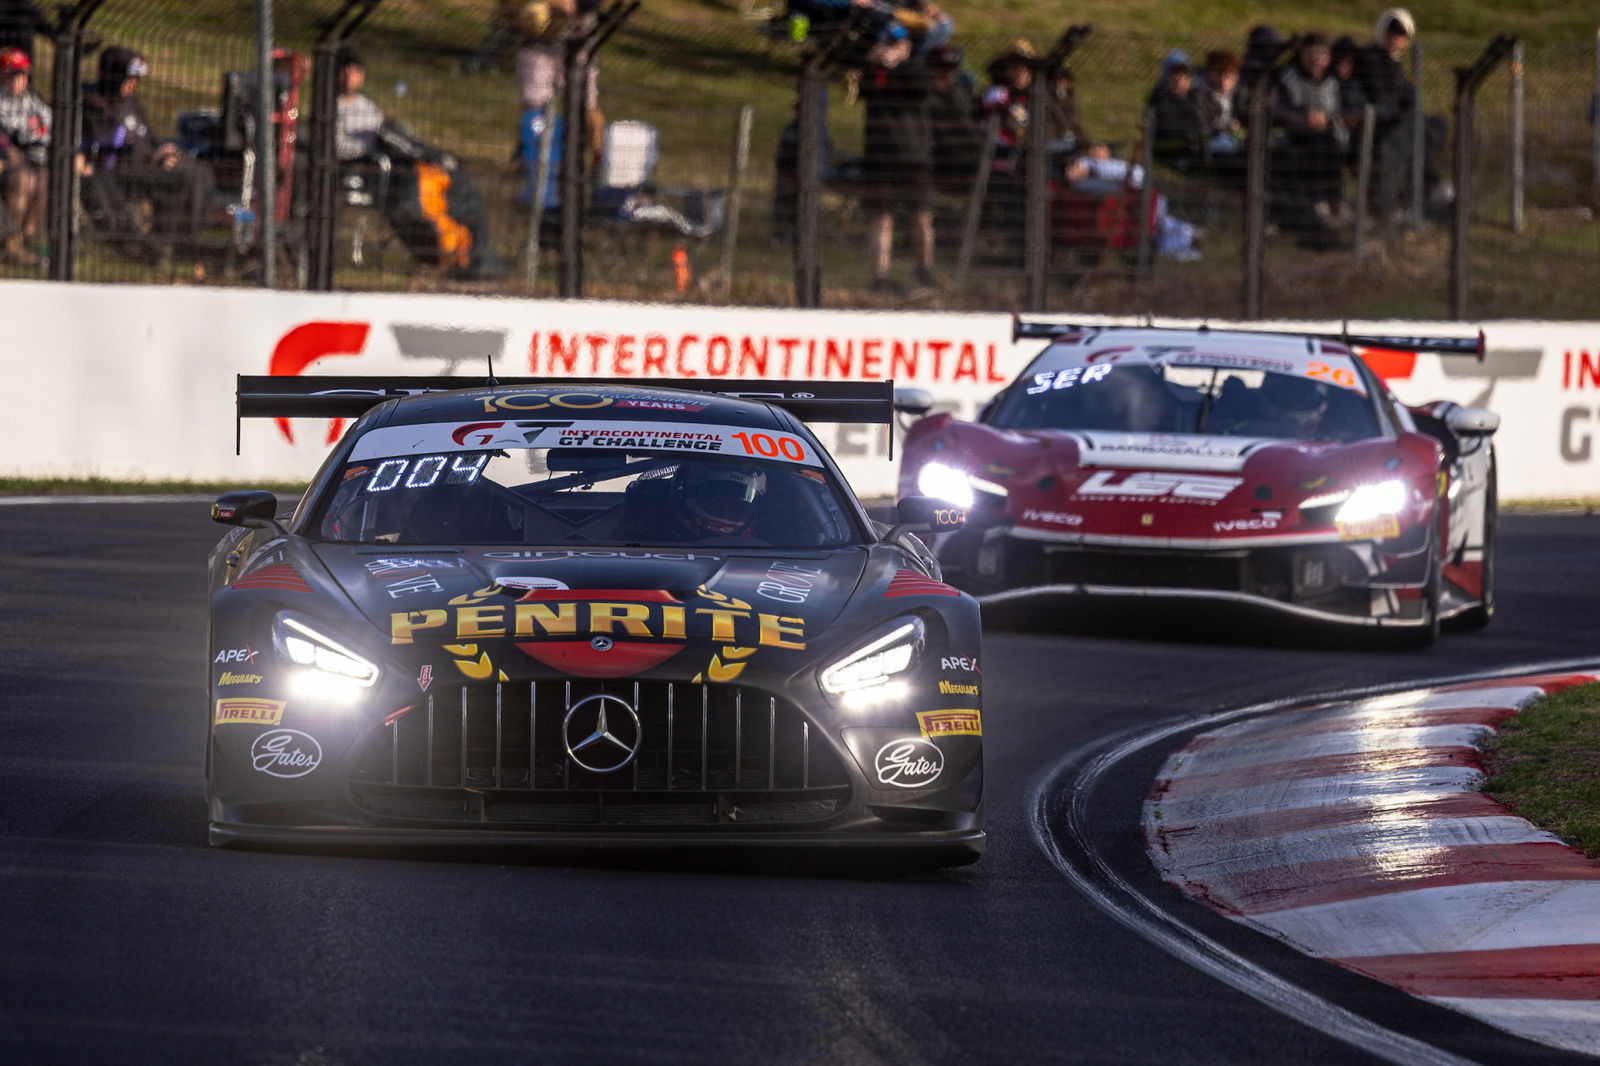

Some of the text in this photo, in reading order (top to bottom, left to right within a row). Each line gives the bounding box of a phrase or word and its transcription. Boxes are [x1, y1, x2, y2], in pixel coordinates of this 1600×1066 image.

[528, 329, 1006, 385] INTERCONTINENTAL
[1026, 362, 1113, 395] SER
[1304, 360, 1356, 387] 26
[626, 400, 686, 410] YEARS
[558, 436, 723, 451] GT CHALLENGE
[561, 429, 724, 442] INTERCONTINENTAL
[730, 431, 806, 463] 100
[366, 453, 488, 492] 004
[934, 508, 960, 525] 100
[1022, 508, 1085, 526] IVECO
[1213, 517, 1278, 533] IVECO
[482, 549, 721, 562] airtouch
[757, 561, 822, 604] GROVE
[390, 601, 807, 650] PENRITE
[214, 644, 260, 664] APEX
[941, 652, 983, 674] APEX
[217, 702, 279, 721] PIRELLI
[922, 713, 980, 733] PIRELLI
[252, 735, 317, 771] Gates
[878, 744, 940, 784] Gates
